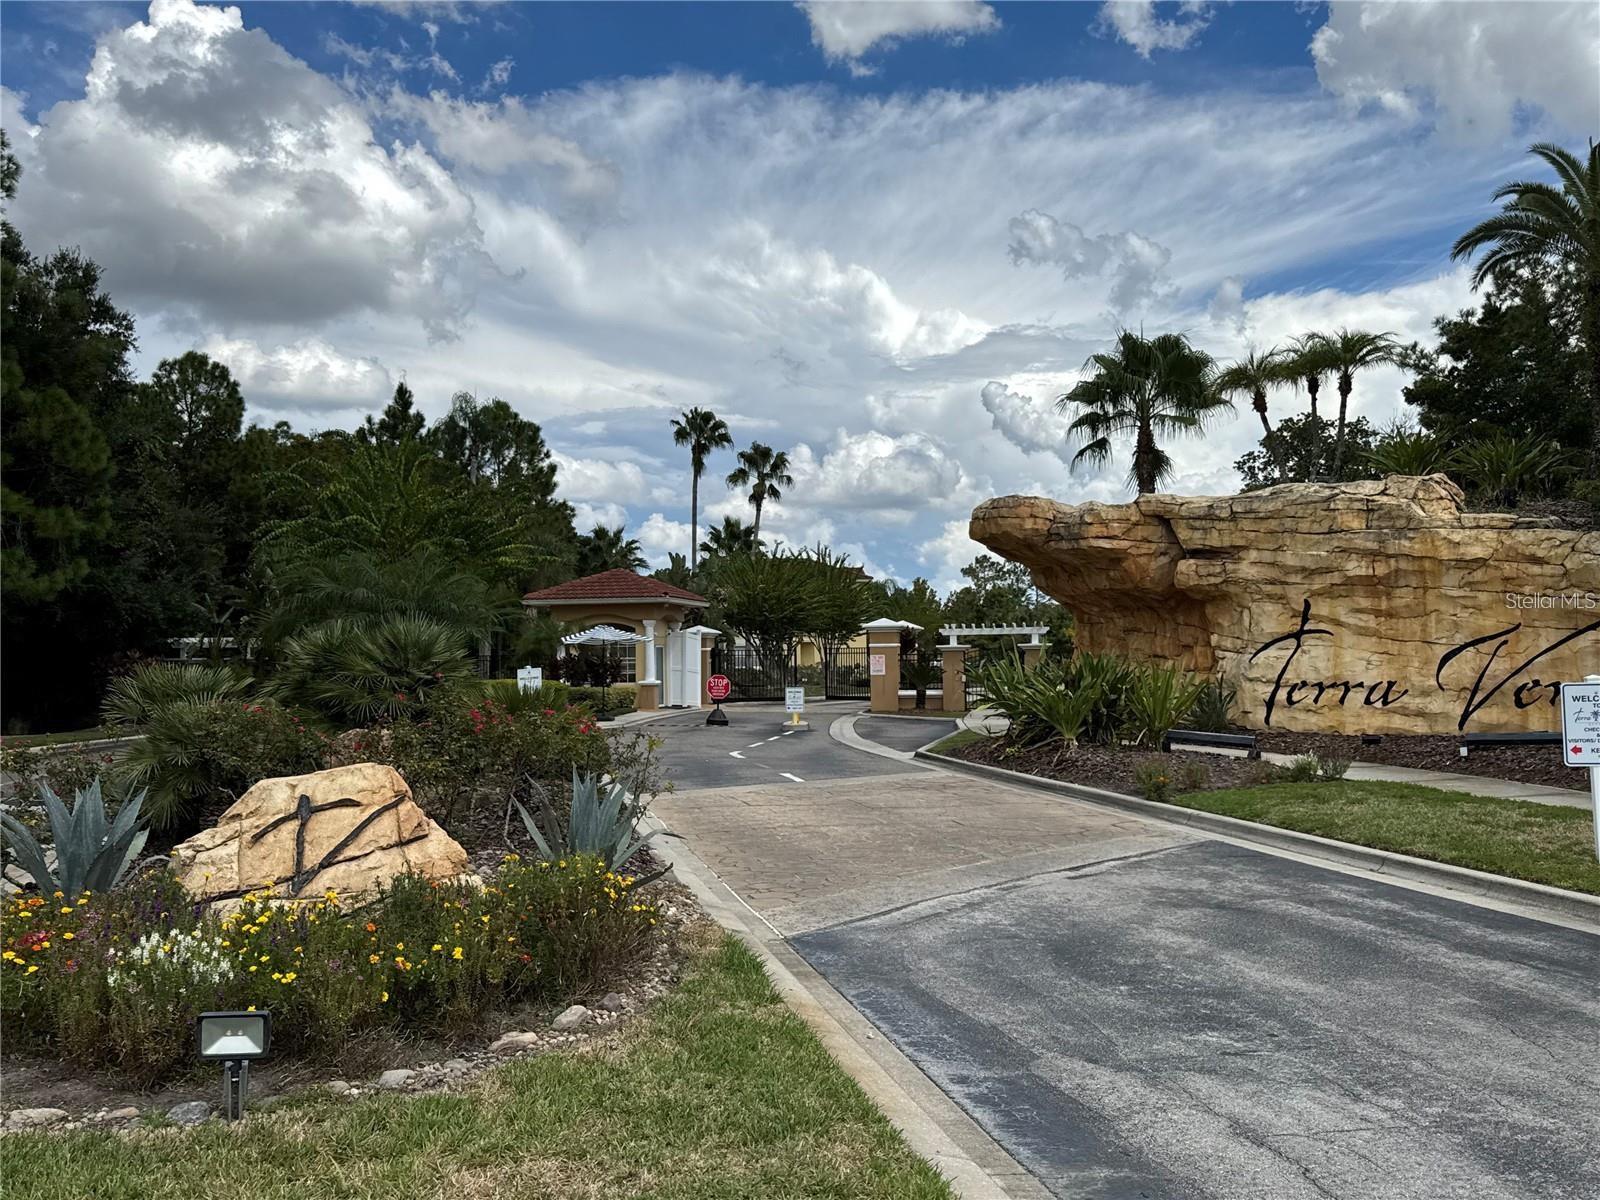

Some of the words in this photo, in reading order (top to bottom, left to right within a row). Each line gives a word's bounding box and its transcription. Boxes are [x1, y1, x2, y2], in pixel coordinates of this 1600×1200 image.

[710, 678, 727, 686] STOP
[1249, 598, 1409, 727] Terra
[1436, 620, 1600, 732] Ver
